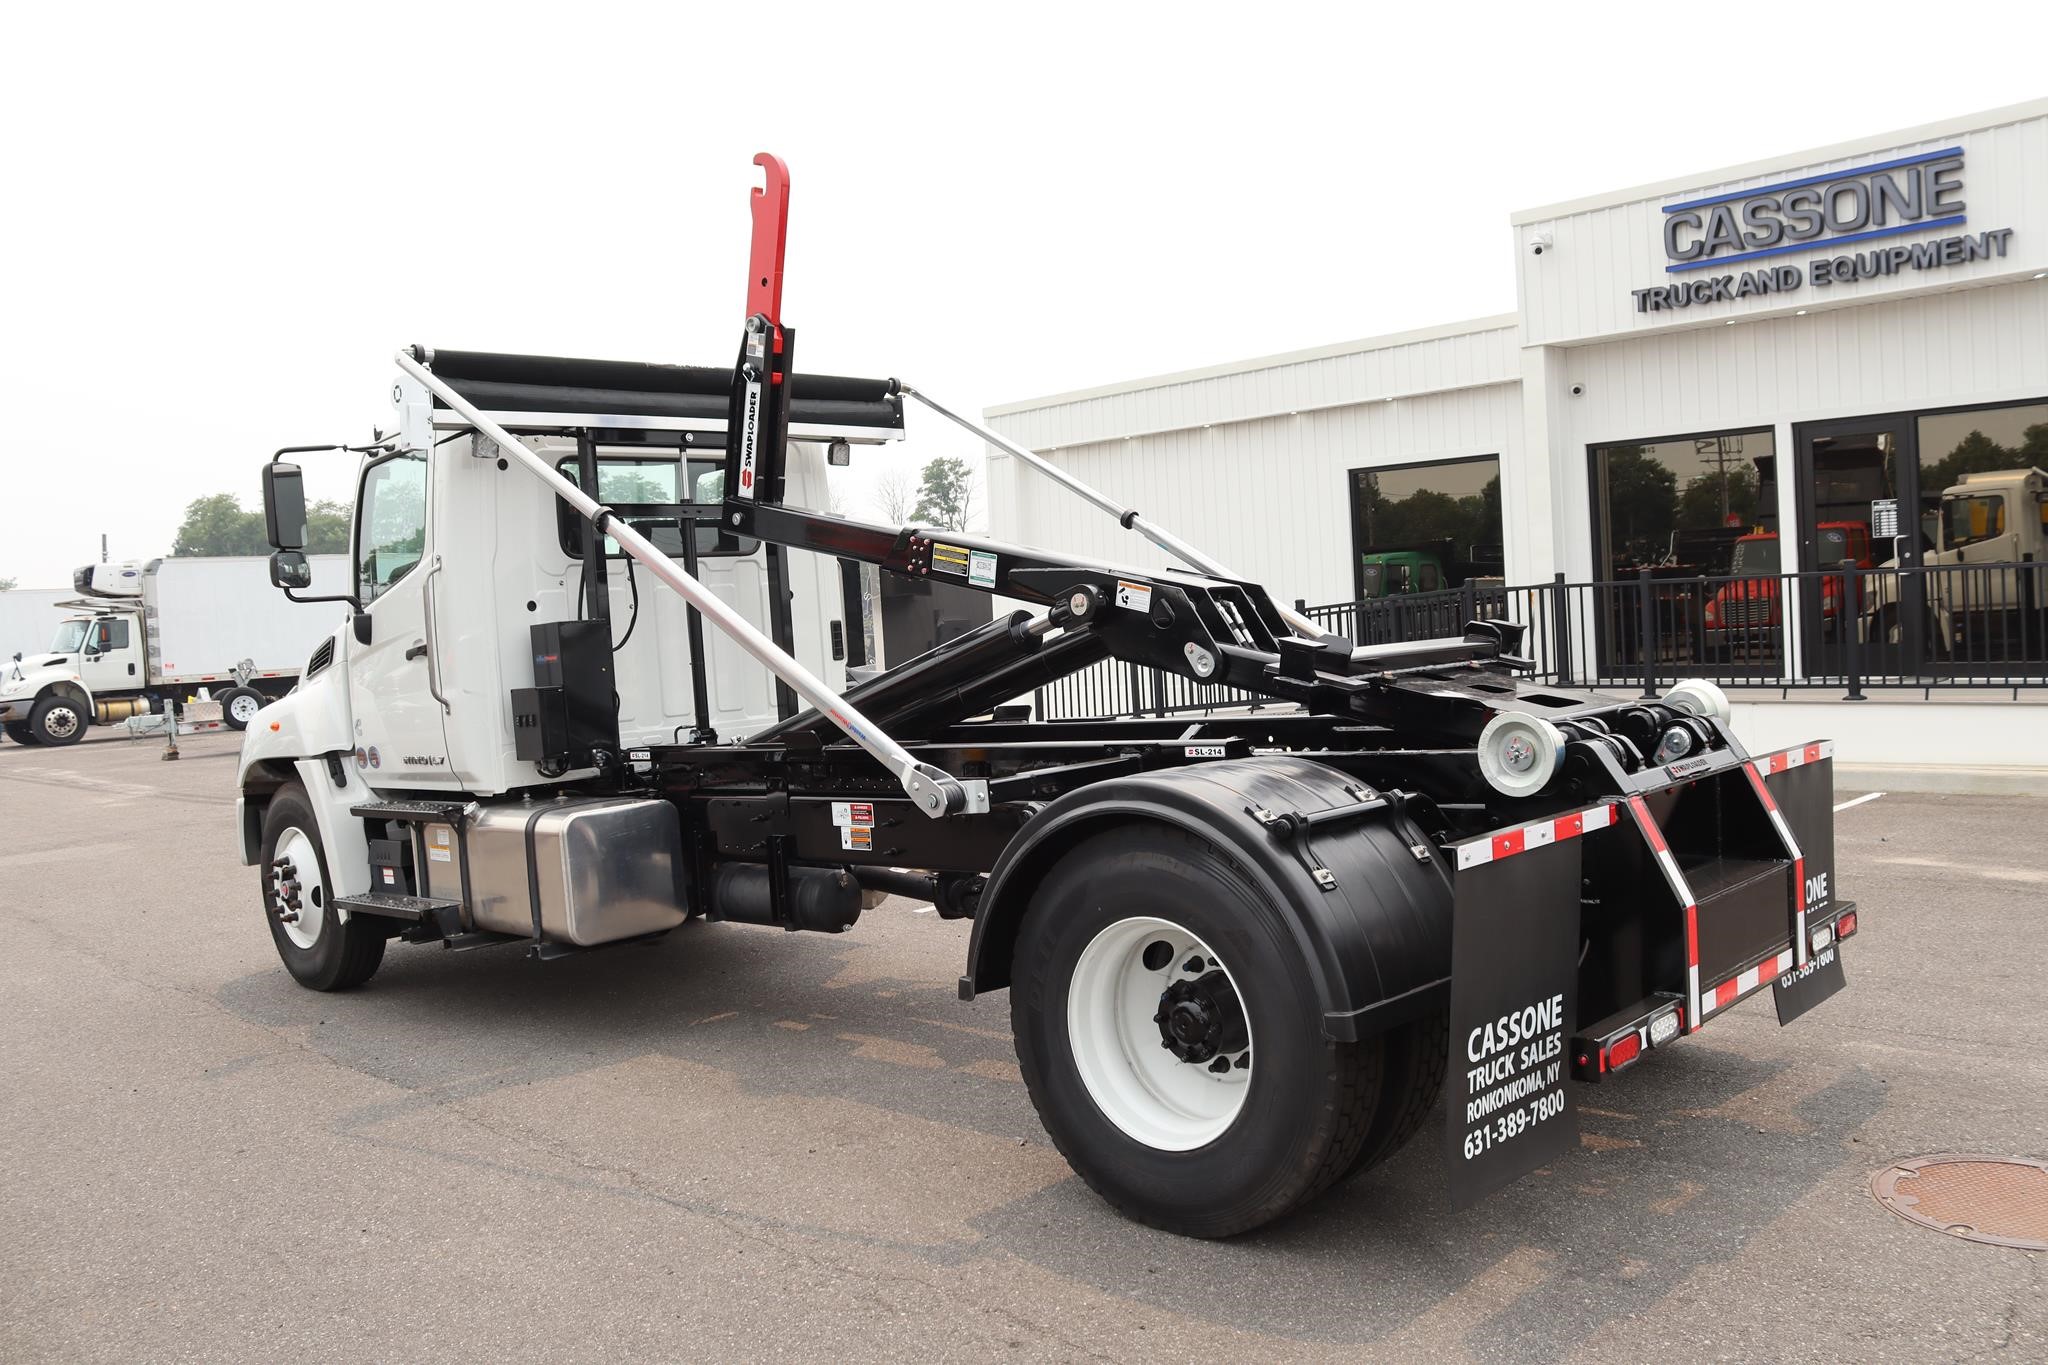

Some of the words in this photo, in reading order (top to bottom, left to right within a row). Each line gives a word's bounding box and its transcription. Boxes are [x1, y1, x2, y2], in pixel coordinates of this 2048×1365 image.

[1663, 158, 1966, 262] CASSONE
[1631, 274, 1736, 313] TRUCK
[1735, 264, 1803, 298] AND
[1809, 227, 2014, 287] EQUIPMENT
[744, 391, 757, 467] SWAPLOADER
[1194, 748, 1222, 756] SL-214
[1467, 993, 1563, 1063] CASSONE
[1467, 1051, 1515, 1094] TRUCK
[1520, 1032, 1562, 1070] SALES
[1464, 1089, 1564, 1159] 631-389-7800
[1466, 1070, 1545, 1124] RONKONKOMA,
[1547, 1061, 1561, 1085] NY
